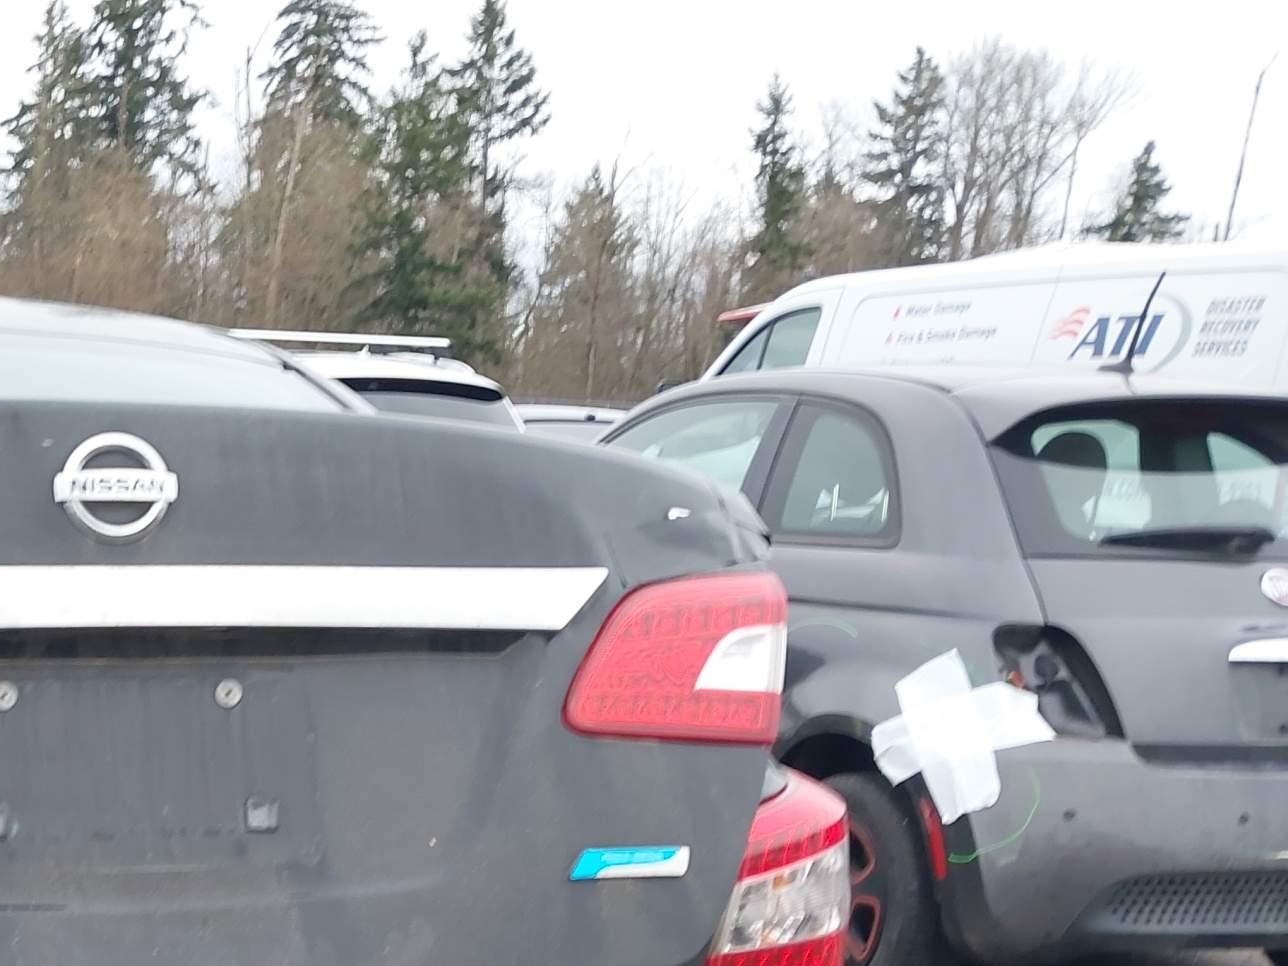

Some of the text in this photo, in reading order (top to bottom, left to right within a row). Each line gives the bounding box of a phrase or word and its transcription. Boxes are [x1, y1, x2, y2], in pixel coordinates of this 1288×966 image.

[1206, 296, 1268, 315] DISASTER
[1067, 313, 1166, 360] ATI
[1199, 319, 1261, 337] RECOVERY
[1192, 340, 1250, 358] SERVICES
[70, 476, 166, 494] NISSAN
